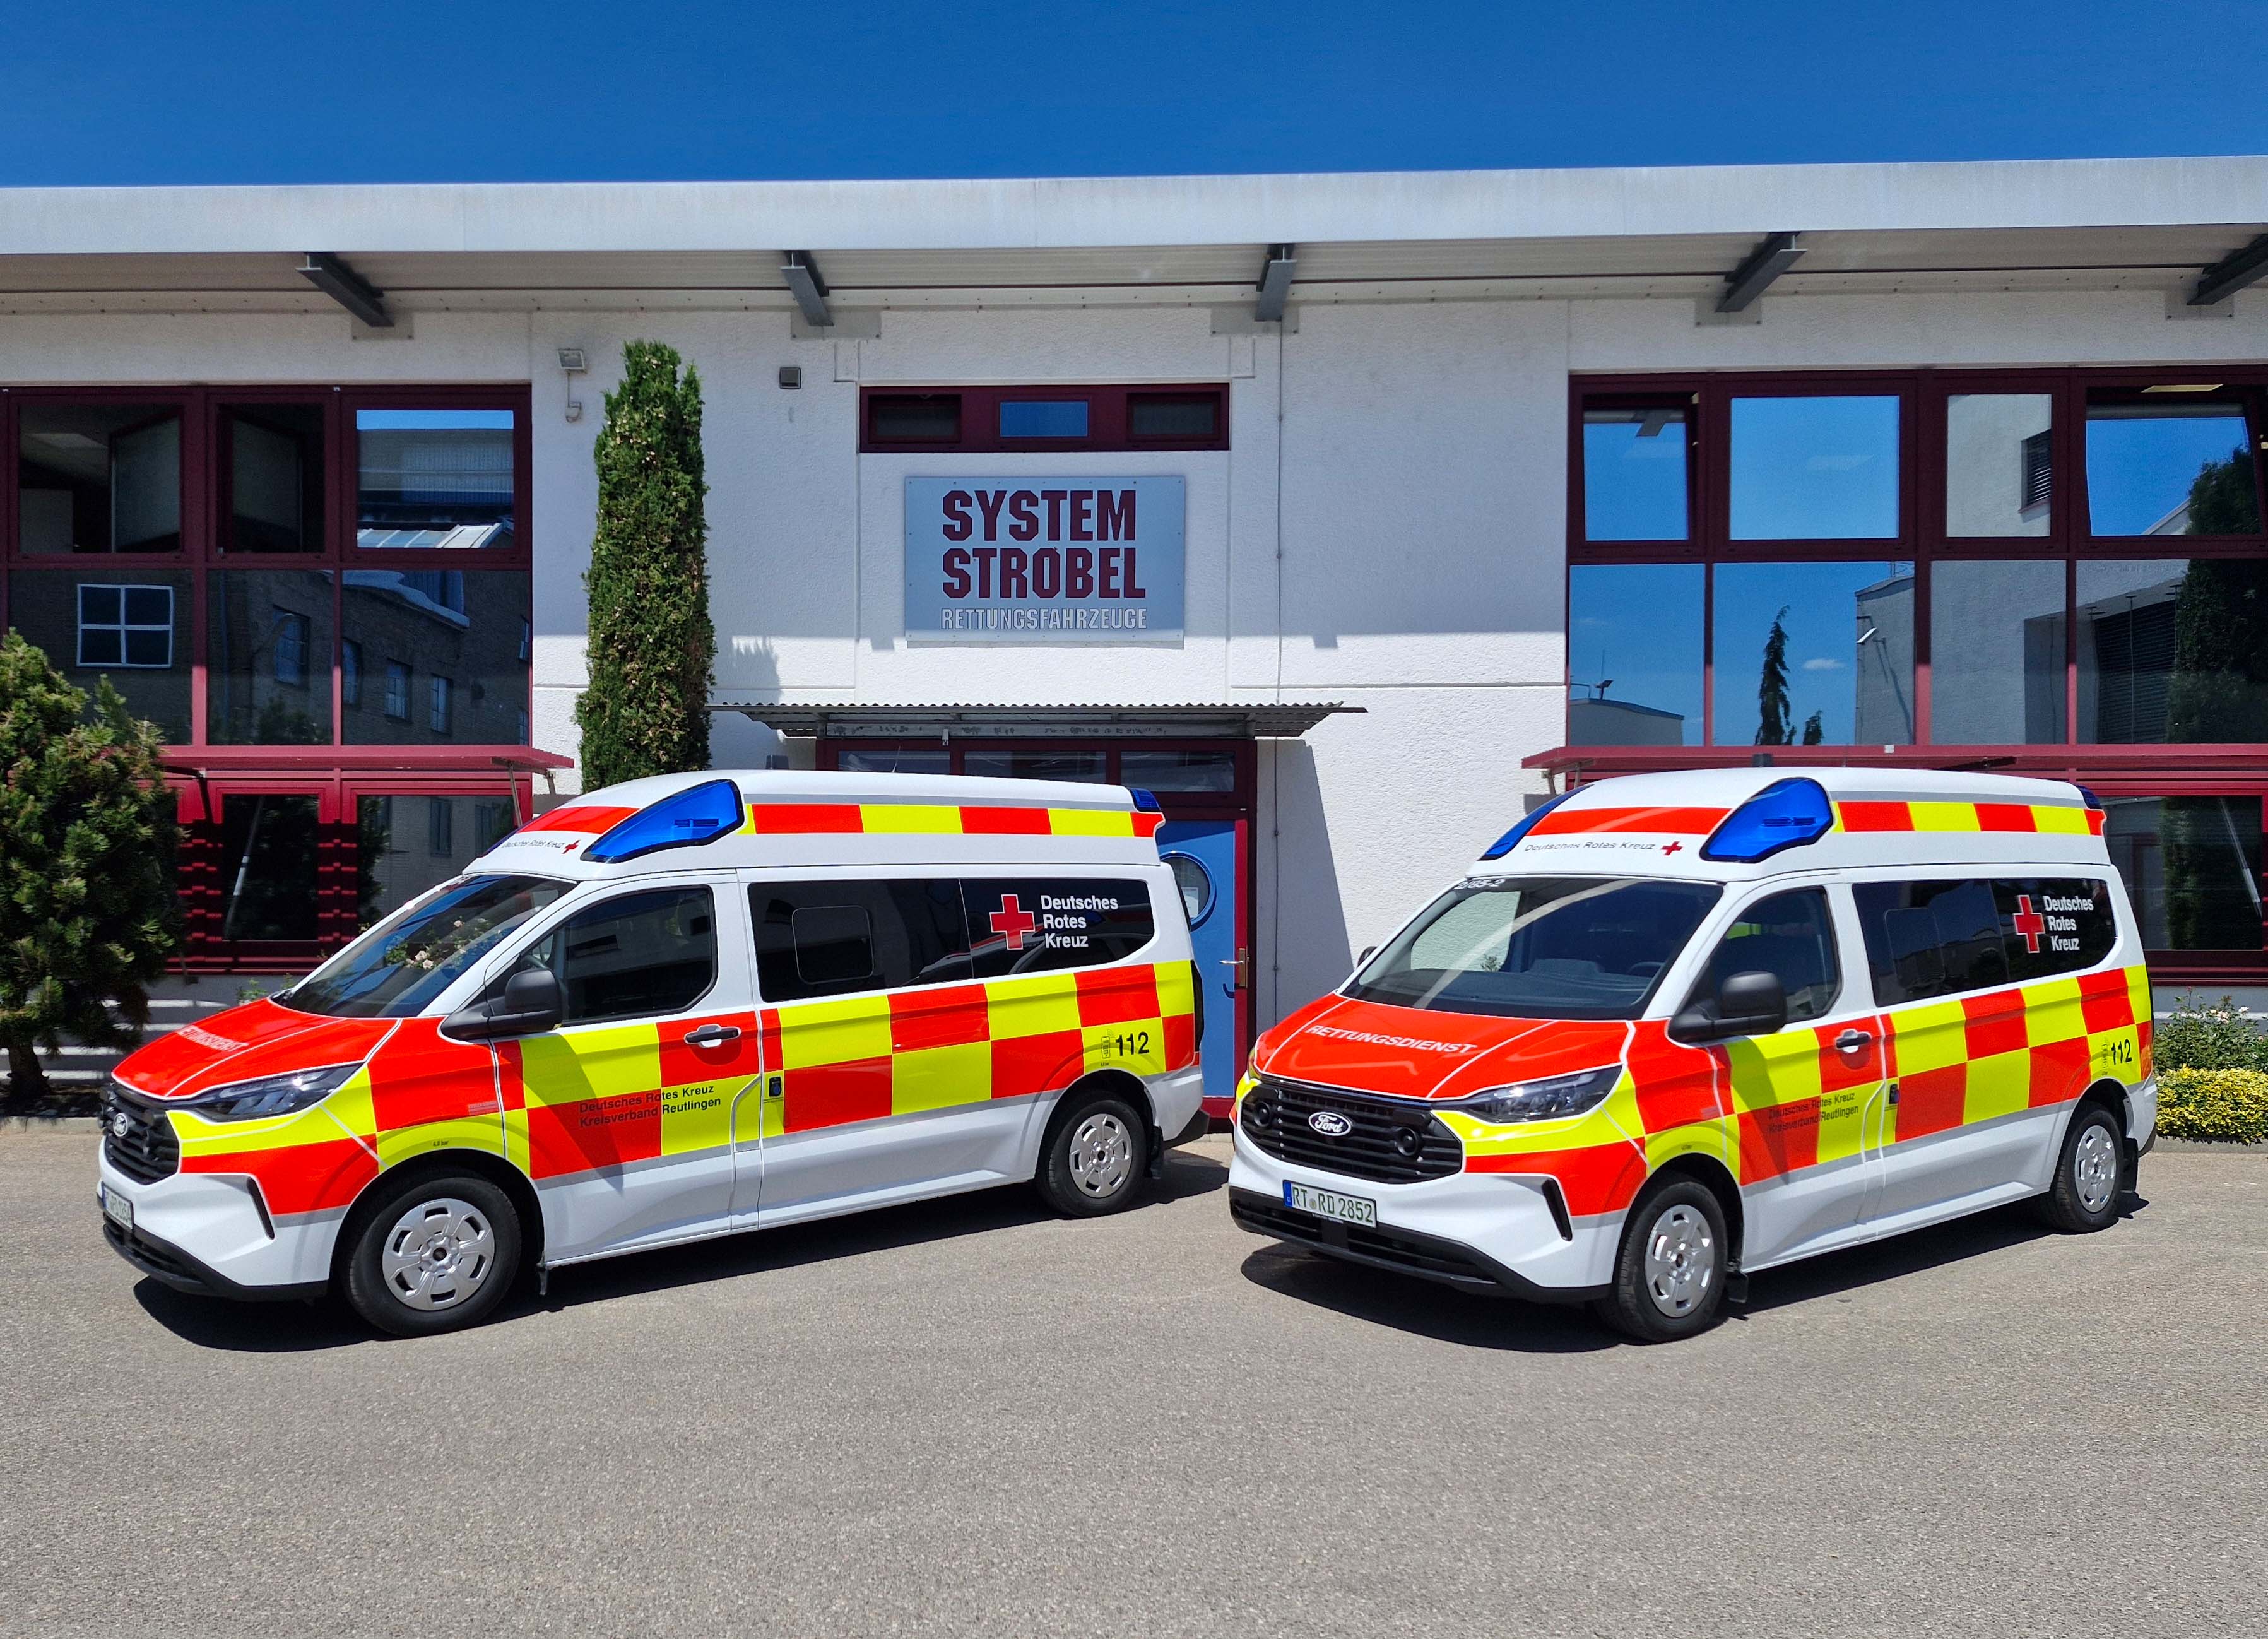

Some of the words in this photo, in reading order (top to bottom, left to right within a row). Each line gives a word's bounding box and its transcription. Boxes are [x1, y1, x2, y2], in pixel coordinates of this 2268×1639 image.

[943, 490, 1136, 541] SYSTEM
[943, 548, 1146, 598] STROBEL
[941, 608, 1147, 630] RETTUNGSFAHRZEUGE
[1525, 841, 1580, 851] Deutsches
[1583, 841, 1617, 849] Rotes
[1619, 841, 1656, 850] Kreuz
[1040, 895, 1119, 909] Deutsches
[2043, 895, 2094, 911] Deutsches
[1042, 913, 1087, 929] Rotes
[2047, 915, 2077, 931] Rotes
[1045, 933, 1089, 948] Kreuz
[2050, 935, 2080, 951] Kreuz
[1115, 1031, 1150, 1056] 112
[1305, 1024, 1478, 1053] RETTUNGSDIENST
[2111, 1038, 2132, 1065] 112
[579, 1096, 642, 1113] Deutsches
[646, 1090, 678, 1103] Rotes
[682, 1086, 714, 1098] Kreuz
[1812, 1098, 1833, 1109] Rotes
[1834, 1092, 1855, 1104] Kreuz
[579, 1108, 658, 1127] Kreisverband
[662, 1097, 721, 1115] Reutlingen
[1821, 1105, 1859, 1121] Reutlingen
[1314, 1115, 1344, 1133] Ford
[1292, 1186, 1308, 1208] RT
[1318, 1192, 1335, 1214] RD
[1338, 1198, 1374, 1223] 2852
